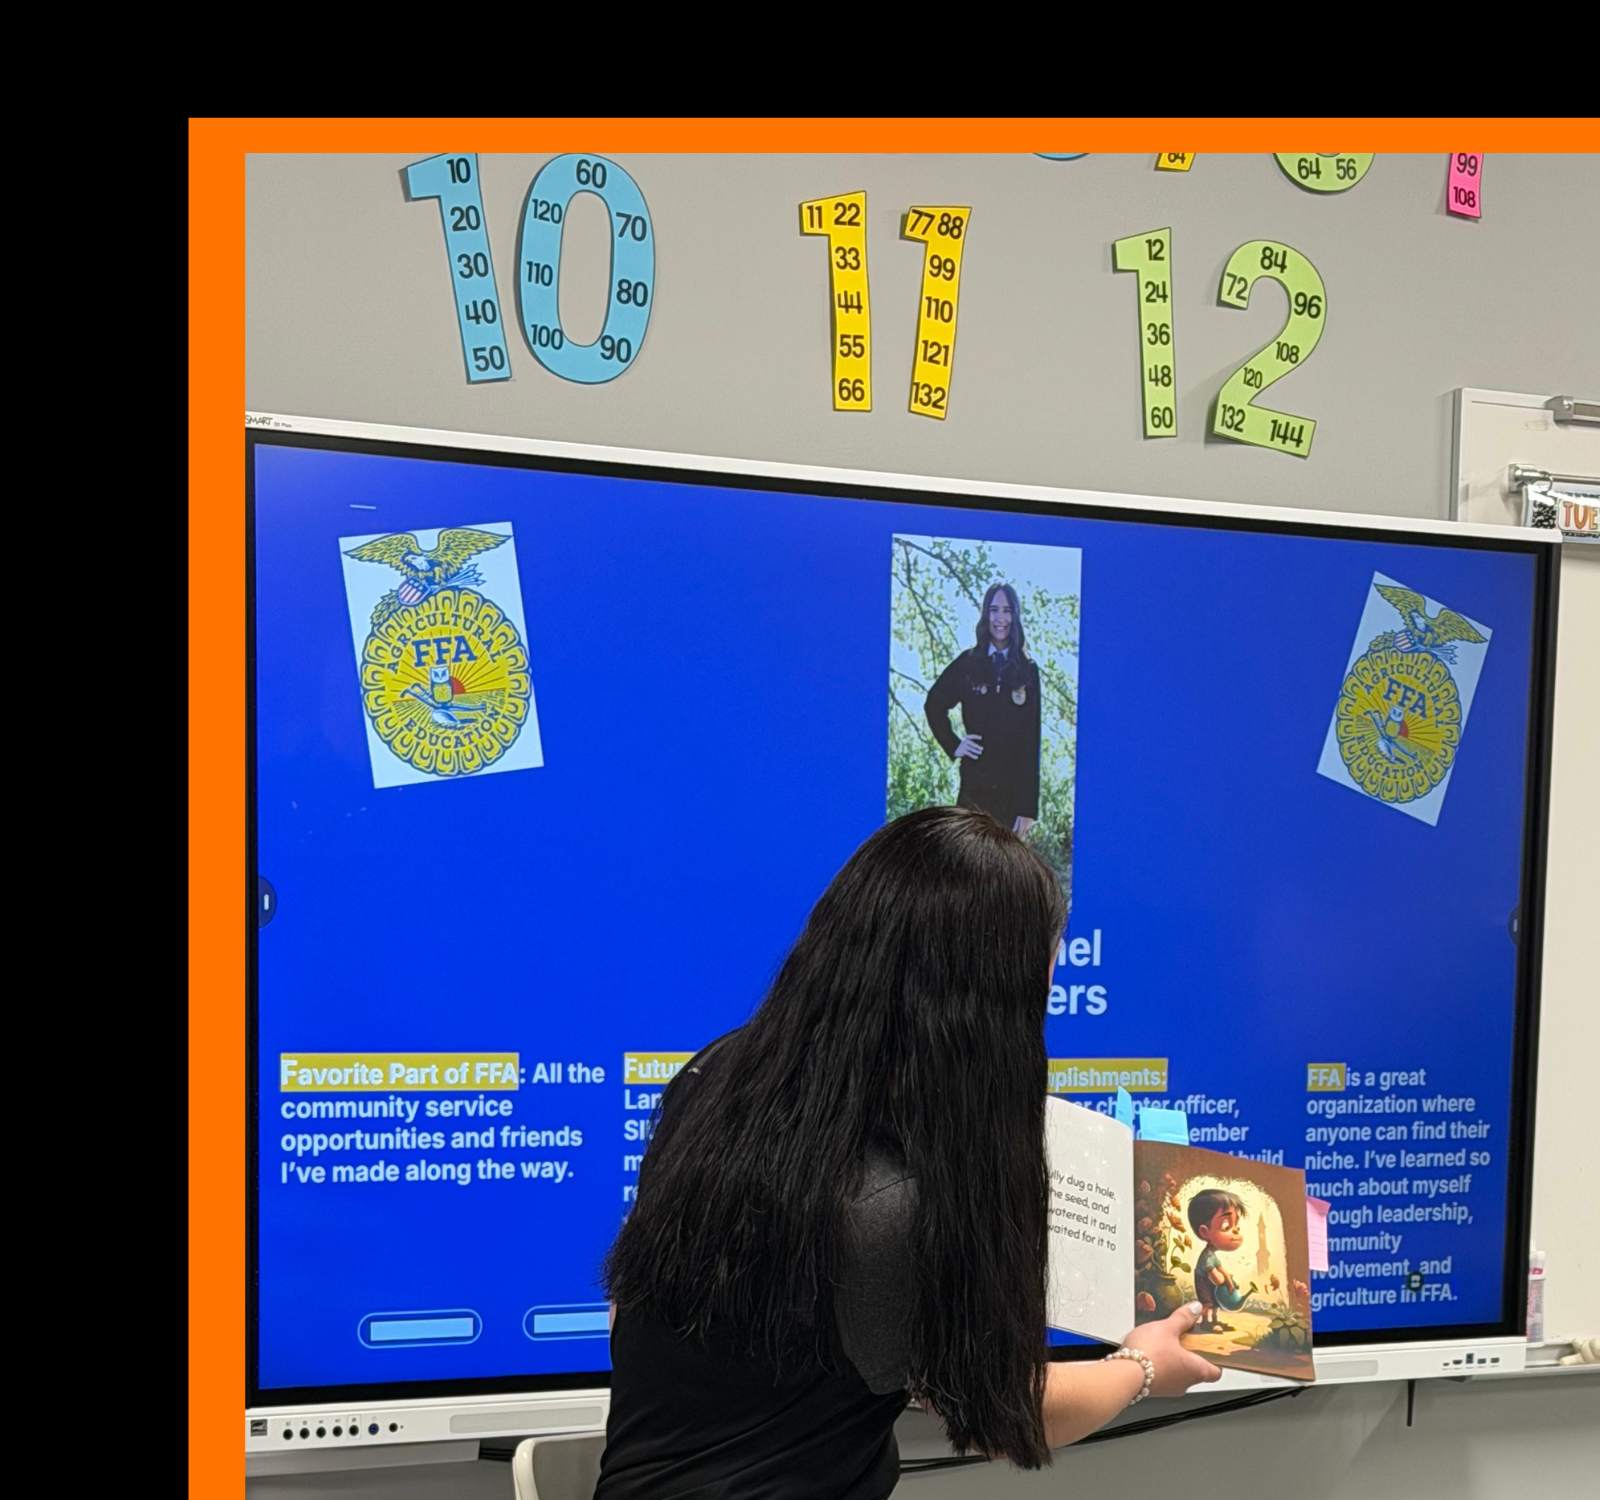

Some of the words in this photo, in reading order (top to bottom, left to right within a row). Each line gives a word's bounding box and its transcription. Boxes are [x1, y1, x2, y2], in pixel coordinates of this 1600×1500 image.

[576, 159, 607, 188] 60
[451, 205, 480, 231] 20
[835, 246, 860, 270] 33
[1261, 247, 1287, 273] 84
[926, 296, 953, 323] 110
[912, 381, 946, 412] 132
[1270, 420, 1304, 447] 144
[412, 635, 478, 667] FFA
[403, 705, 500, 751] EDUCATION
[281, 1059, 384, 1086] Favorite
[389, 1064, 439, 1084] Part
[445, 1062, 469, 1084] of
[474, 1064, 526, 1083] FFA:
[532, 1063, 562, 1084] All
[568, 1063, 605, 1084] the
[1308, 1069, 1341, 1086] FFA
[1347, 1068, 1360, 1085] is
[1365, 1072, 1375, 1085] a
[1380, 1069, 1426, 1091] great
[281, 1095, 419, 1123] community
[426, 1095, 513, 1117] service
[1307, 1094, 1417, 1119] organization
[1422, 1095, 1475, 1112] where
[281, 1127, 445, 1156] opportunities
[451, 1127, 494, 1148] and
[500, 1126, 582, 1147] friends
[1306, 1127, 1371, 1146] anyone
[1376, 1126, 1407, 1140] can
[1412, 1121, 1446, 1139] find
[1450, 1120, 1490, 1138] their
[333, 1161, 399, 1182] made
[406, 1160, 471, 1185] along
[477, 1159, 515, 1179] the
[521, 1162, 573, 1183] way.
[1067, 1174, 1085, 1191] dug
[1087, 1182, 1093, 1191] a
[1091, 1201, 1110, 1214] and
[1377, 1202, 1472, 1224] leadership,
